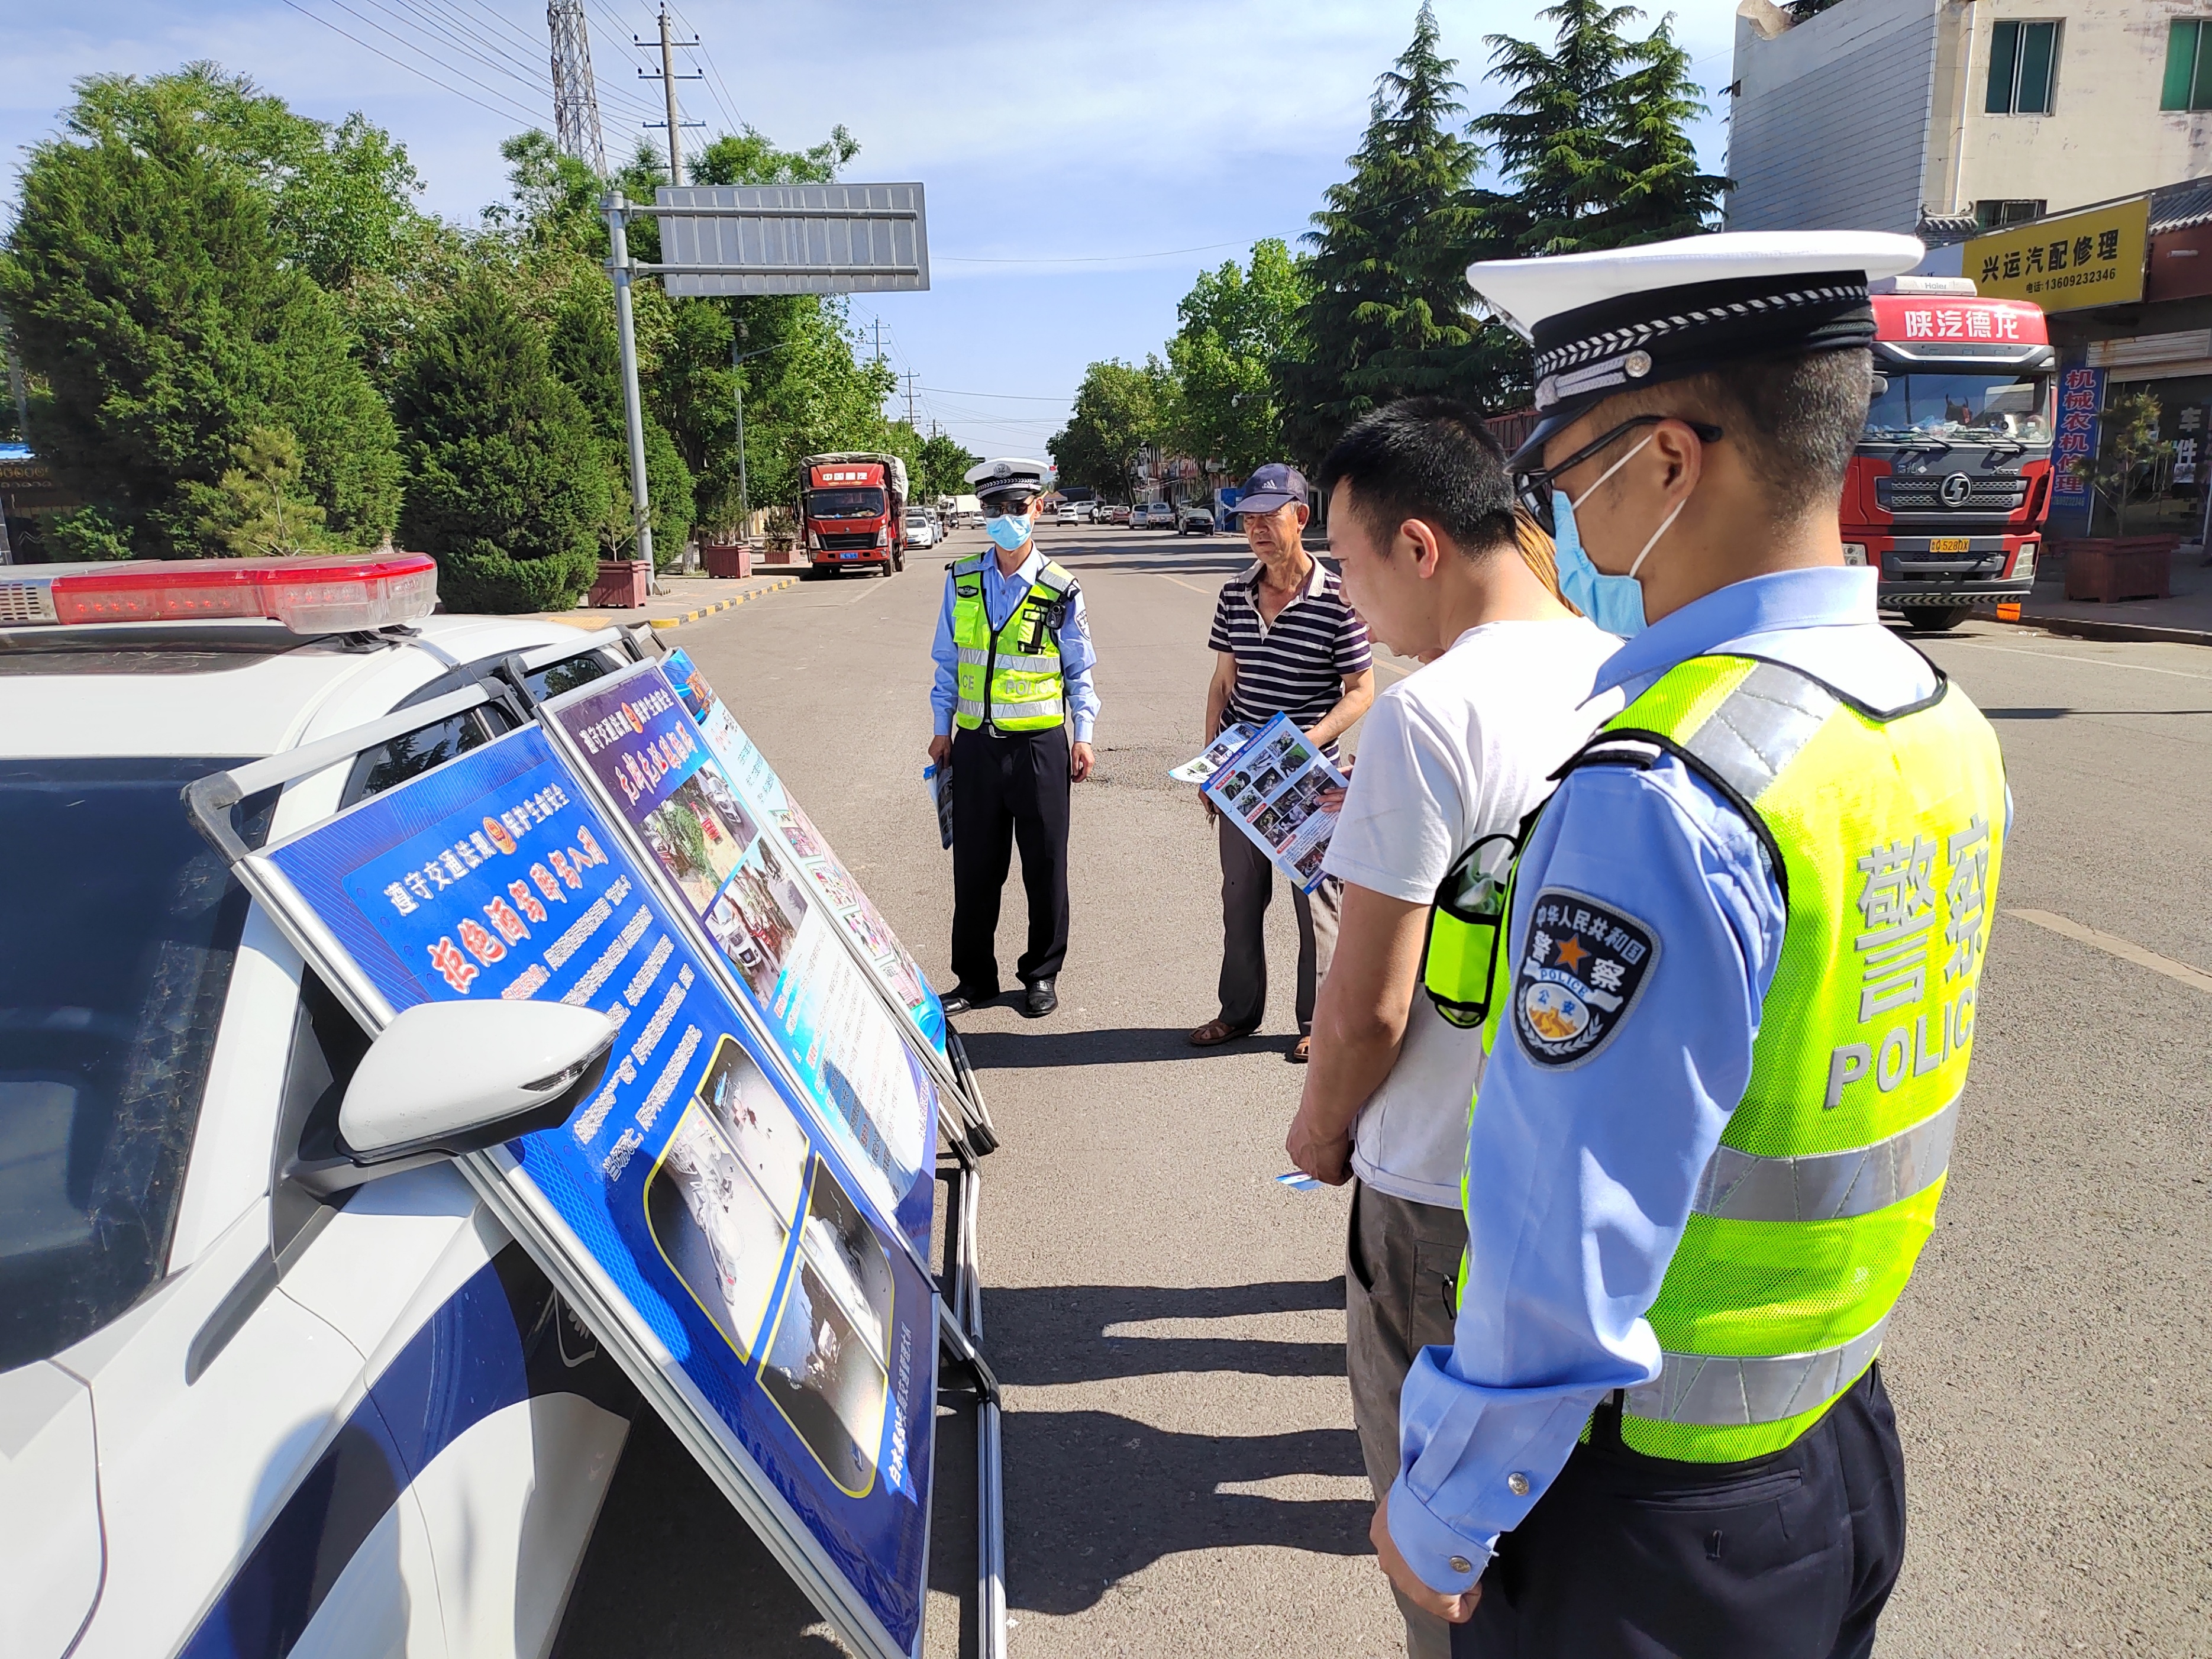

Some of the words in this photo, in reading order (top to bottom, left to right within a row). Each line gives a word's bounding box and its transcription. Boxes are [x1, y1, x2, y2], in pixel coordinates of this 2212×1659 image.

[1981, 229, 2119, 283] 兴运汽配修理
[1904, 310, 2019, 340] 陕汽德龙
[959, 674, 974, 690] ICE
[1006, 678, 1057, 695] POLICE
[578, 712, 632, 754] 遵守交通法规
[635, 689, 674, 725] 保护生命安全
[383, 830, 496, 916] 遵守交通法规
[500, 782, 570, 840] 保护生命安全
[427, 825, 609, 995] 拒绝酒驾醉驾入刑
[1536, 903, 1647, 966] 中华人民共和国
[1854, 812, 1989, 1024] 警察
[1541, 969, 1588, 999] POLICE
[1823, 979, 1980, 1109] POLIC
[890, 1321, 911, 1490] 白水县公安局交通管理大队
